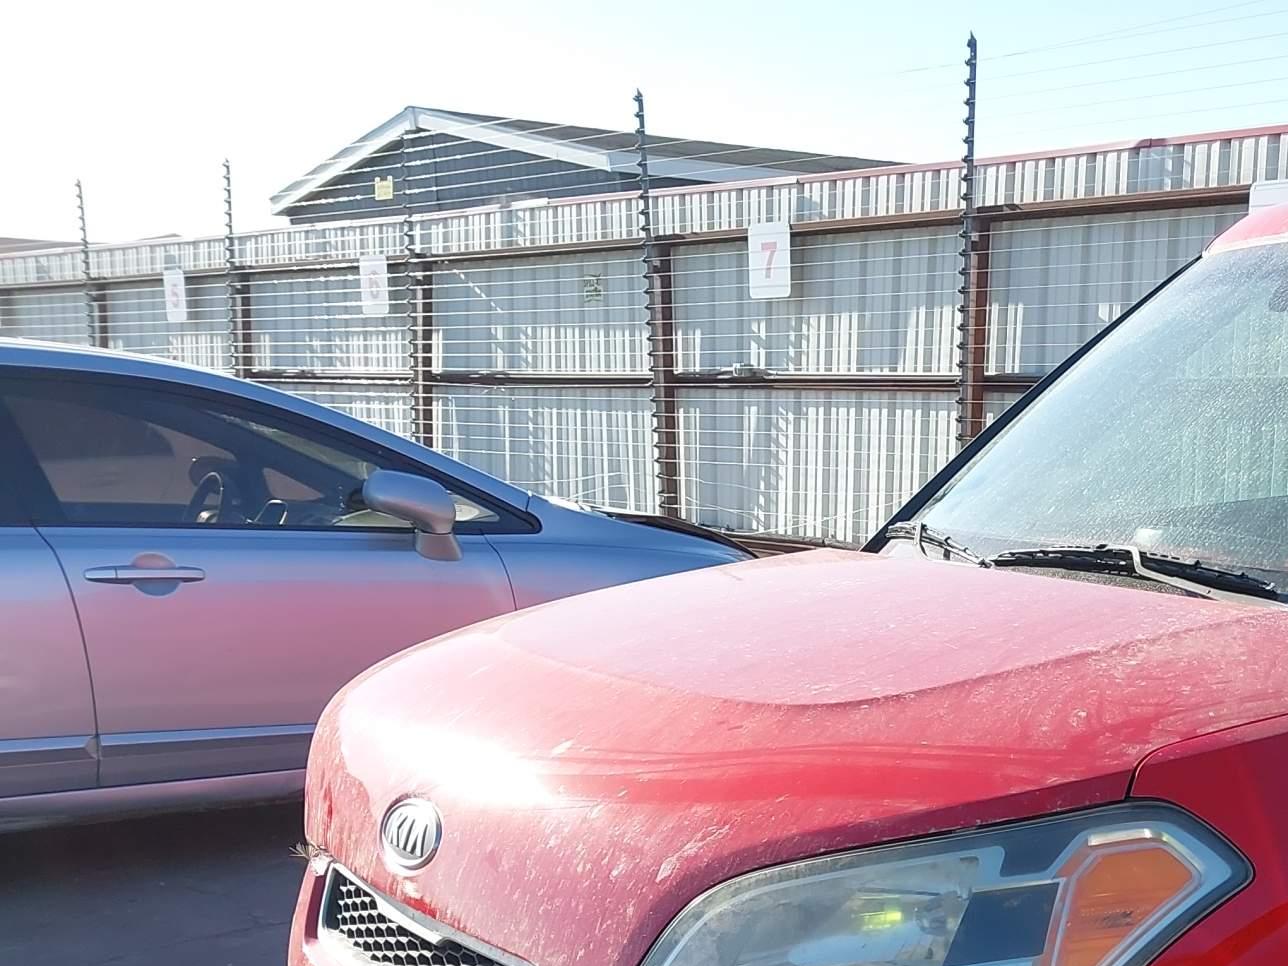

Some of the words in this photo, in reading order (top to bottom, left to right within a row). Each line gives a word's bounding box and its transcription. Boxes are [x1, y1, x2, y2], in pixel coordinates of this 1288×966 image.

[761, 241, 777, 279] 7
[170, 284, 180, 309] 5
[385, 813, 430, 858] KIA
